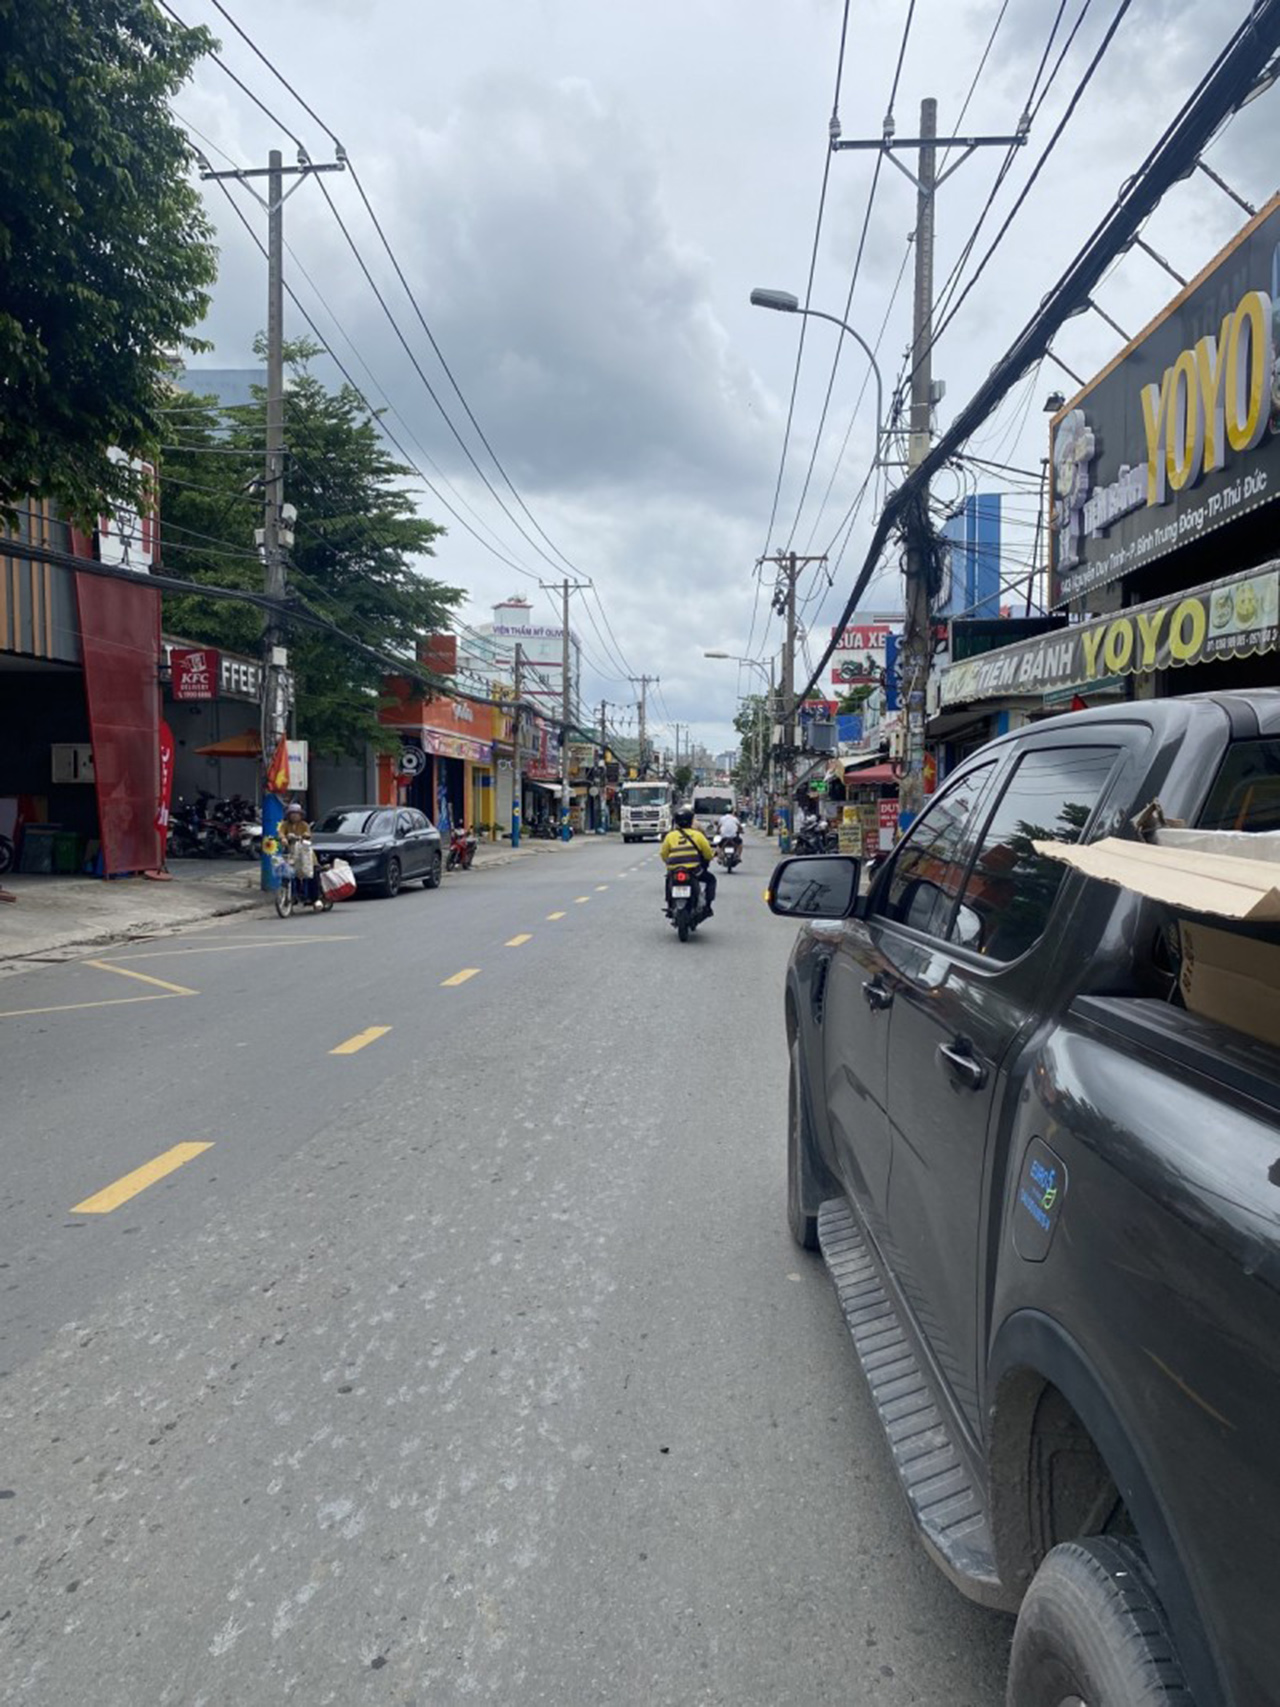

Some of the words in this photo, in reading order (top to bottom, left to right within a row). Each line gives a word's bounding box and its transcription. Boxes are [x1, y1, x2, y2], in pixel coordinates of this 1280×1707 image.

[1140, 290, 1271, 508] YOYO
[1243, 468, 1268, 499] Đức
[978, 653, 1019, 693] TIỆM
[1018, 640, 1074, 682] BÁNH
[1081, 597, 1206, 679] YOYO
[181, 673, 209, 683] KFC
[222, 661, 256, 694] FFEE
